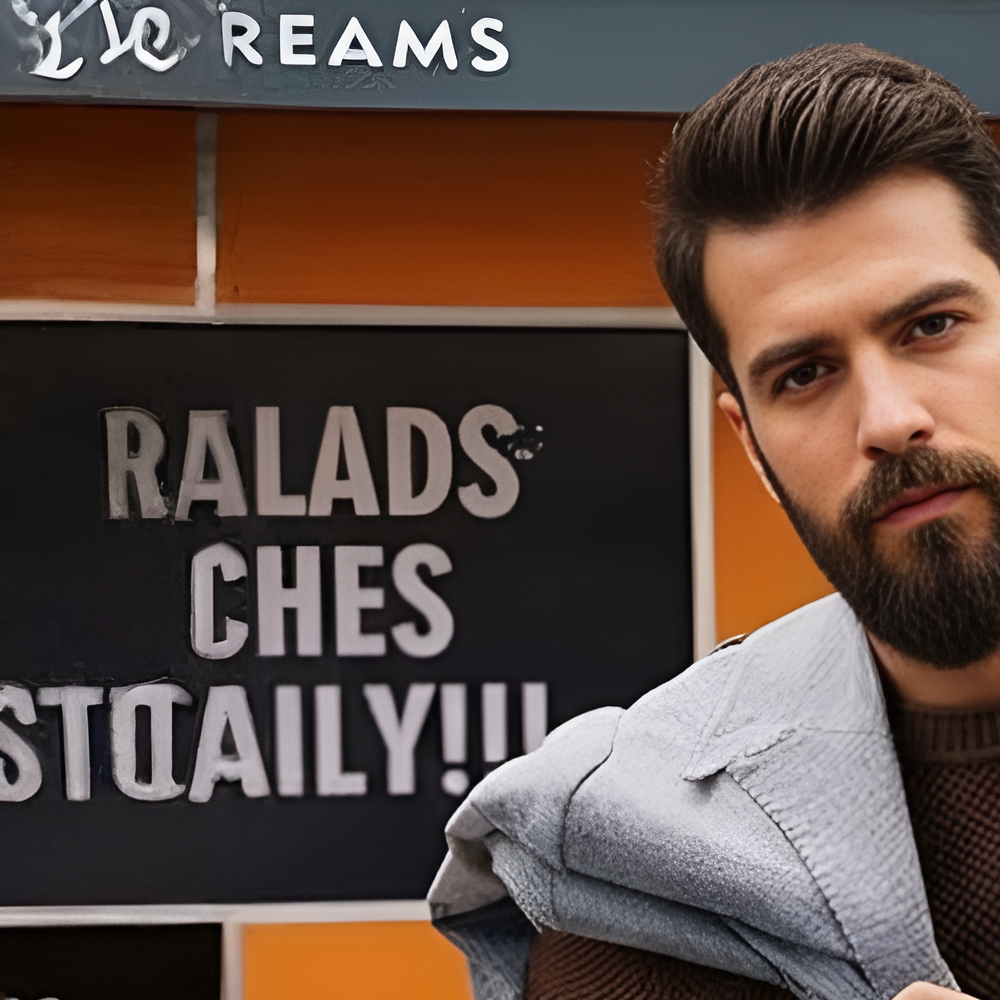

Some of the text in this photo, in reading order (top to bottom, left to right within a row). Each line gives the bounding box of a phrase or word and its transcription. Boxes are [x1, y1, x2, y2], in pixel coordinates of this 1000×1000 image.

[222, 11, 510, 73] REAMS
[104, 403, 520, 521] RALADS
[190, 542, 455, 660] CHES
